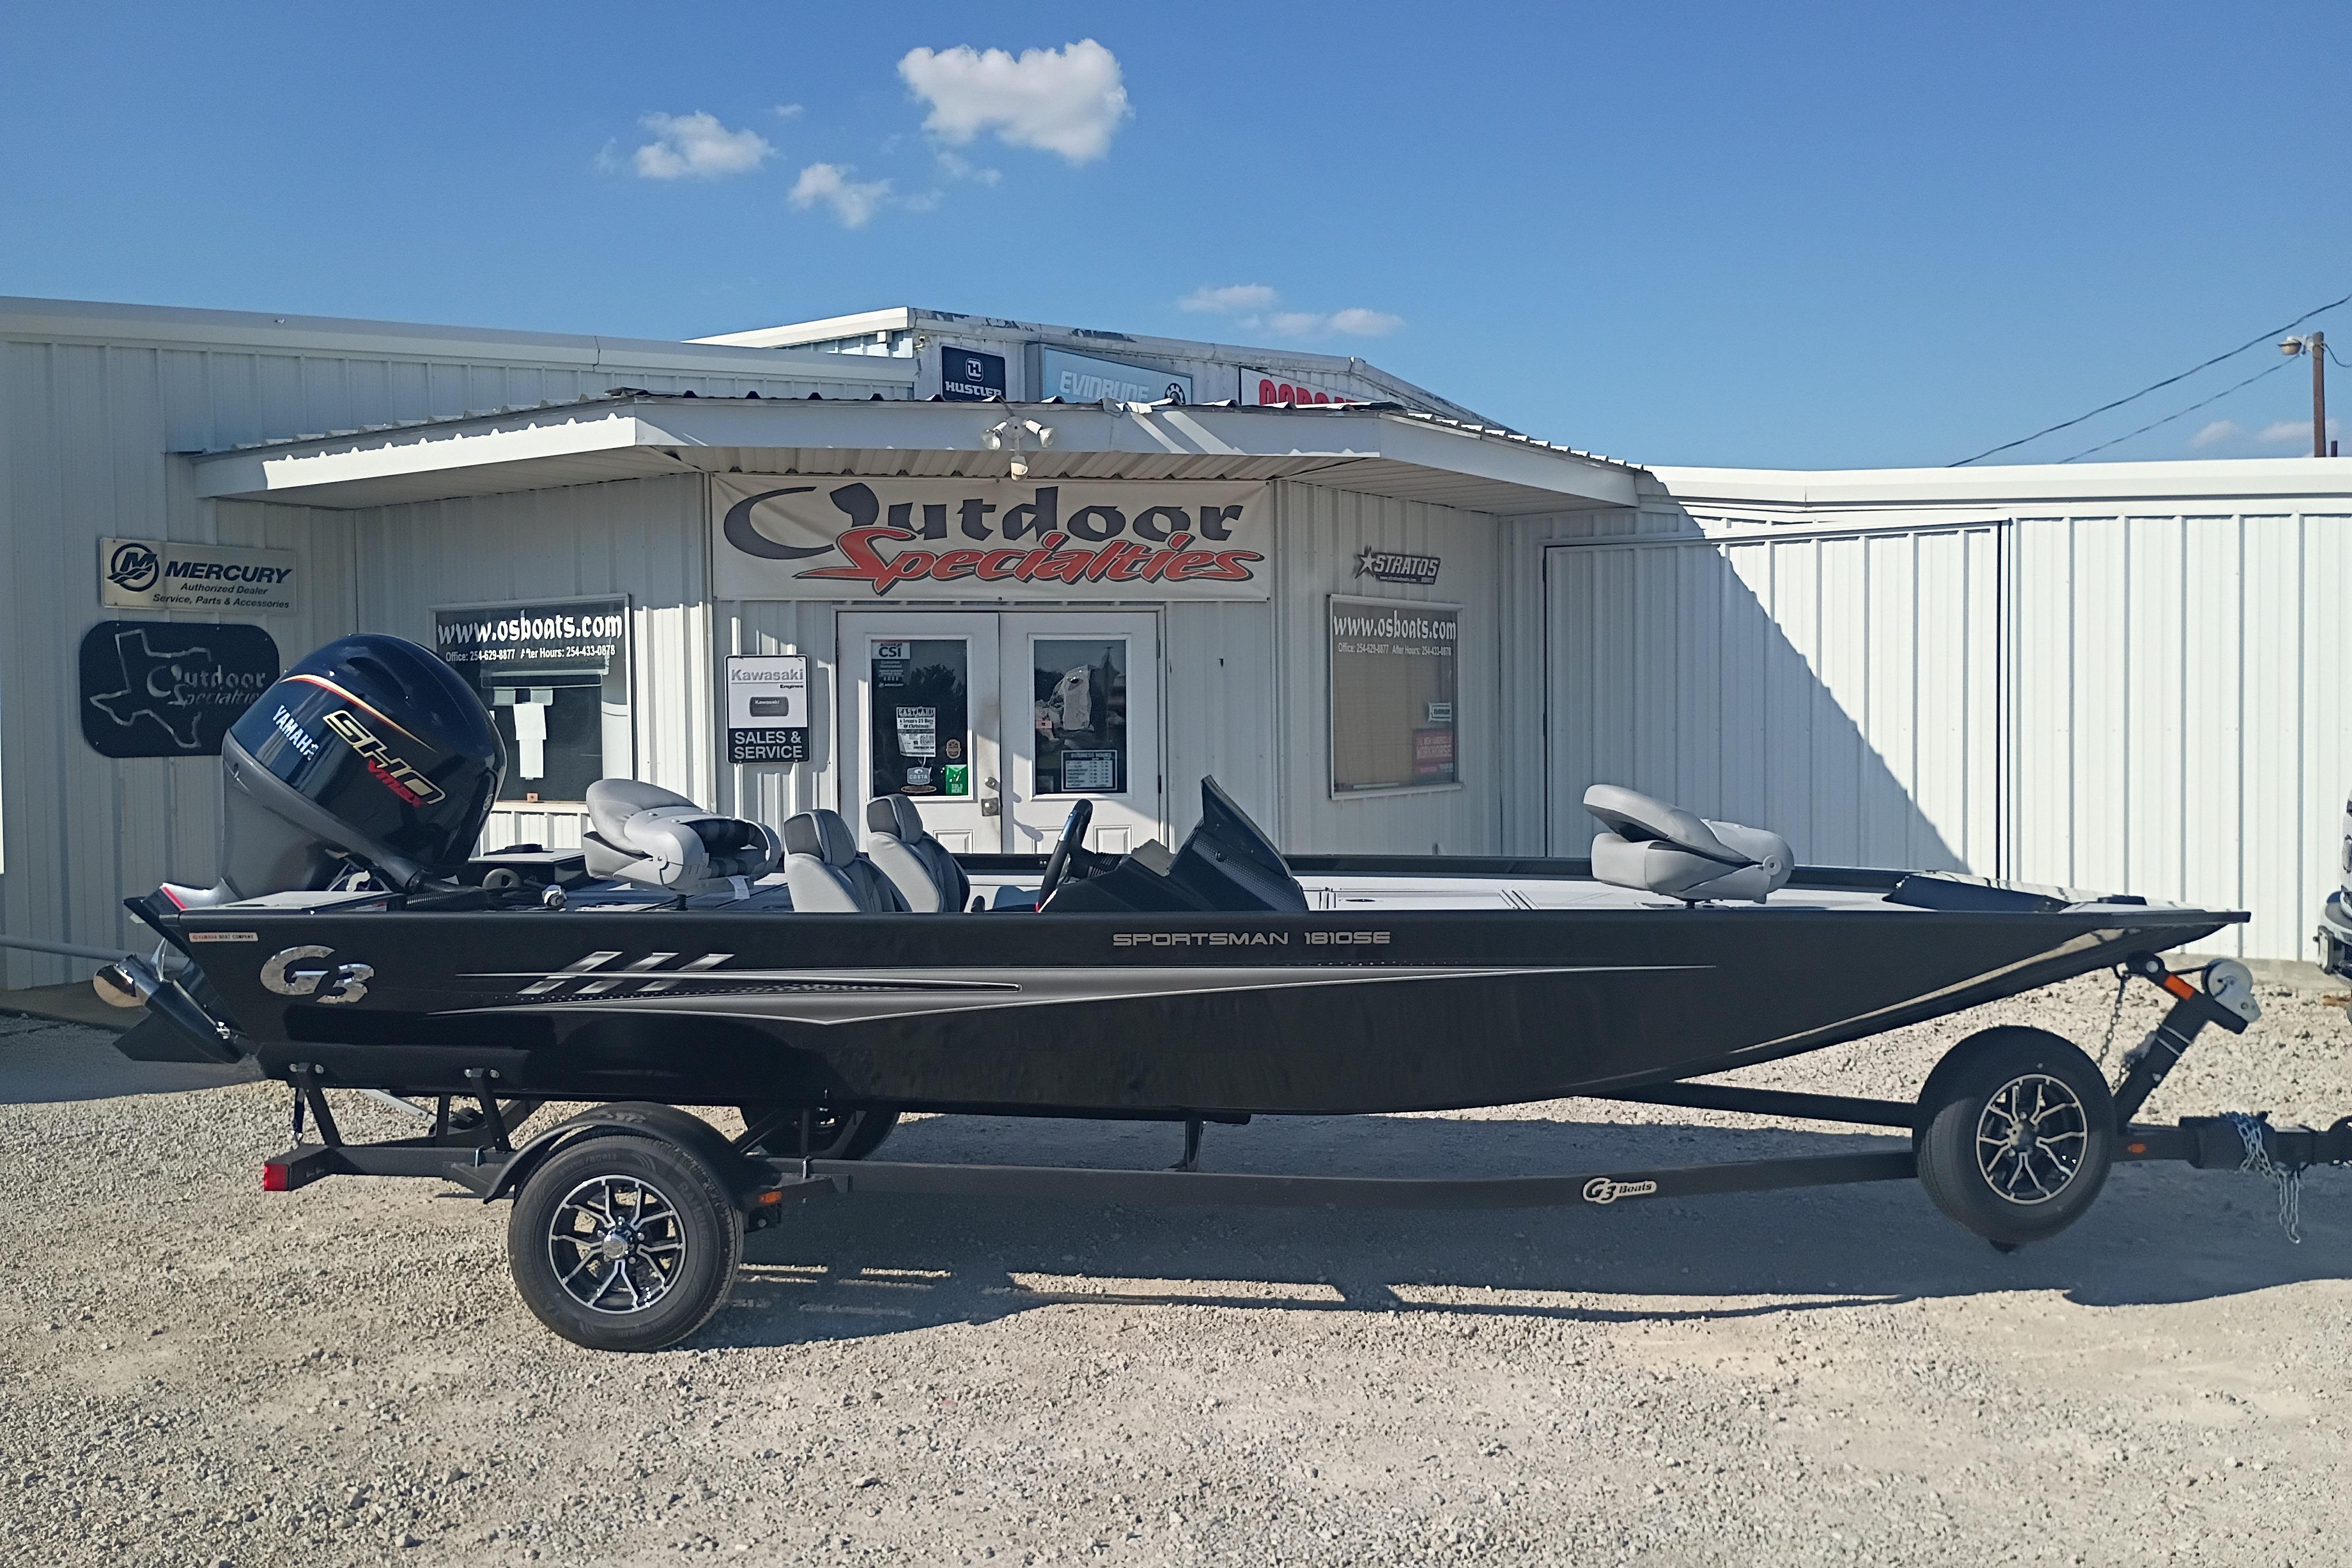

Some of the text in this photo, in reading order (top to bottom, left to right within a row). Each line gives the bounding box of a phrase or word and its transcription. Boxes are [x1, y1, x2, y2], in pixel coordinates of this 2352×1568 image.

[945, 381, 1002, 397] HUSTLER
[724, 483, 1244, 560] Outdoor
[791, 527, 1264, 597] Specialties
[1374, 555, 1438, 576] STRATOS
[165, 561, 292, 583] MERCURY
[180, 583, 268, 595] Authorized Dealer
[153, 594, 192, 605] Service,
[196, 596, 221, 605] Parts
[233, 598, 289, 609] Accessories
[438, 610, 622, 645] www.osboats.com
[1334, 610, 1456, 641] www.osboats.com
[446, 645, 616, 662] Office: 254-629-8877 After Hours: 254-433-0878
[879, 647, 902, 657] CSI
[1338, 642, 1355, 653] Office:
[146, 664, 266, 698] Outdoor
[731, 669, 803, 681] Kawasaki
[272, 705, 319, 761] YAMAHA
[734, 731, 802, 745] SALES &
[734, 746, 803, 759] SERVICE
[1113, 931, 1390, 946] SPORTSMAN 1810SE
[260, 945, 374, 1004] G3
[1586, 1180, 1652, 1201] G3 Boats
